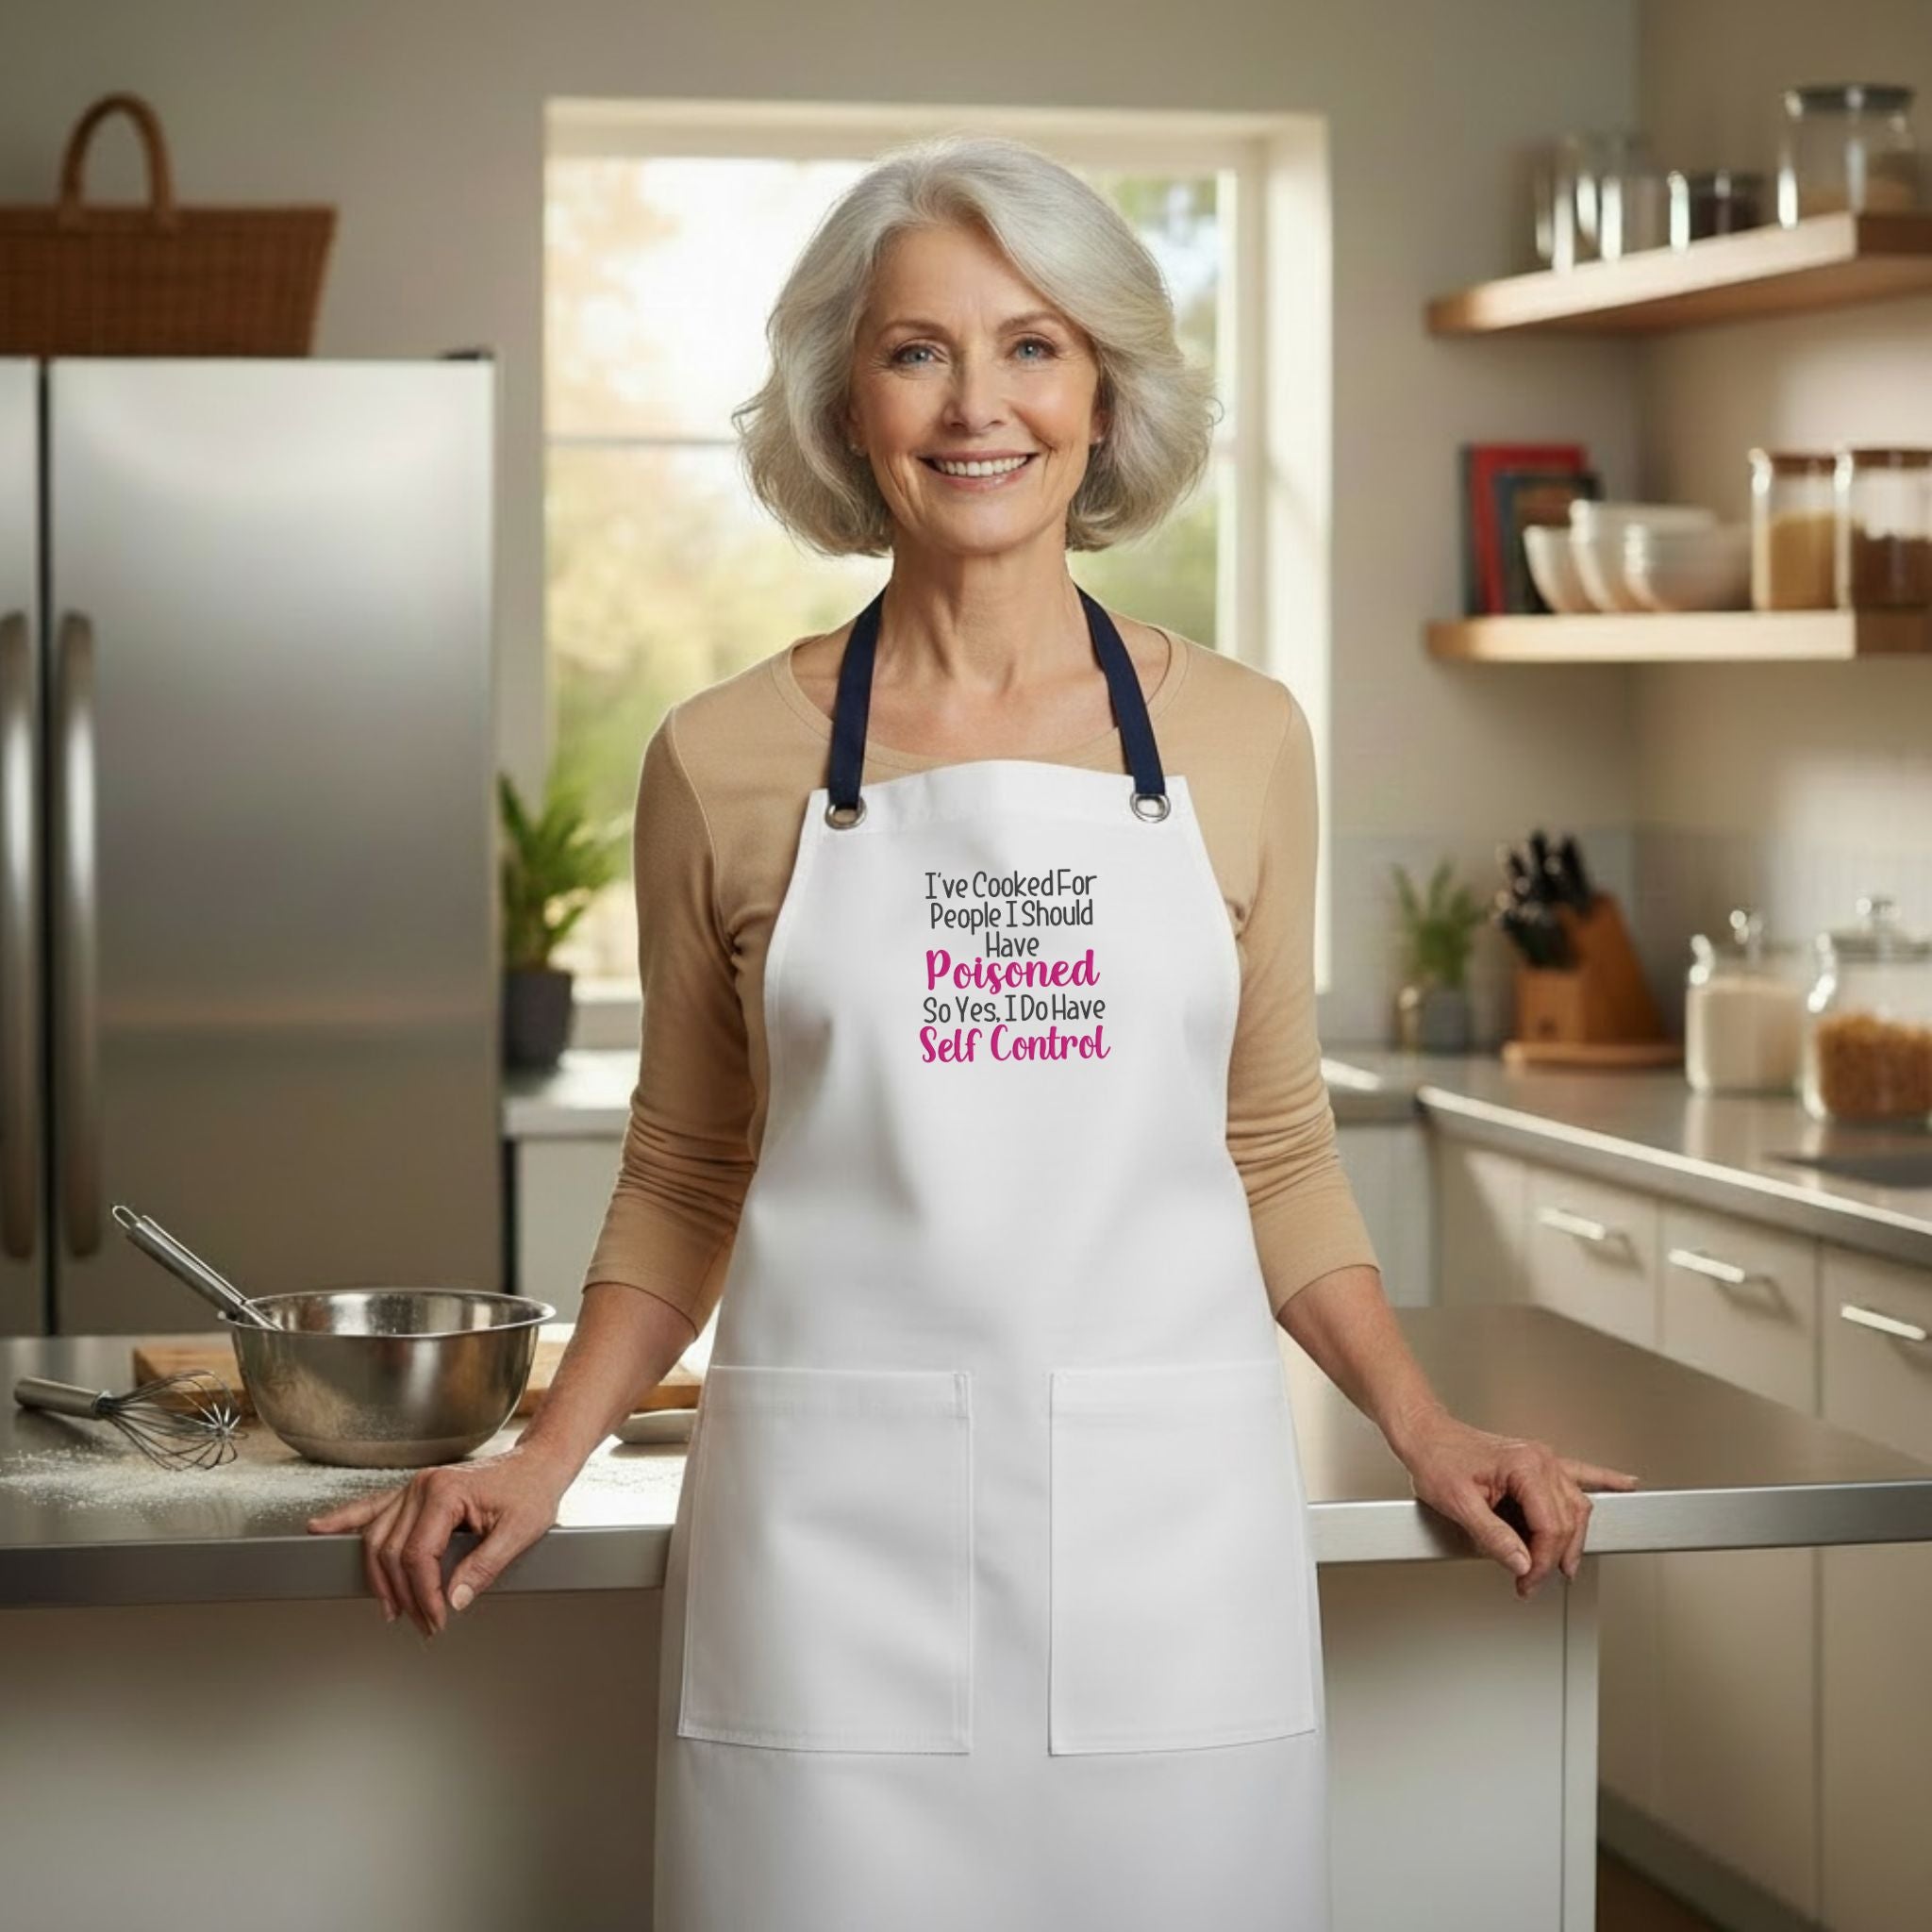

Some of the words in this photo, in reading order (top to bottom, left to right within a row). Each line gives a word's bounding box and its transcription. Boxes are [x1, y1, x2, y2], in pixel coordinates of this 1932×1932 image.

[924, 872, 969, 900] I've
[972, 869, 1054, 898] Cooked
[1057, 868, 1098, 896] For
[930, 902, 1002, 936] People
[1005, 900, 1019, 928] I
[1021, 898, 1093, 927] Should
[985, 930, 1041, 958] Have
[925, 948, 1101, 995] Poisoned
[923, 995, 952, 1024] So
[1004, 993, 1018, 1023] I
[1020, 993, 1049, 1022] Do
[1051, 992, 1107, 1021] Have
[919, 1024, 983, 1063] Self
[990, 1024, 1111, 1061] Control
